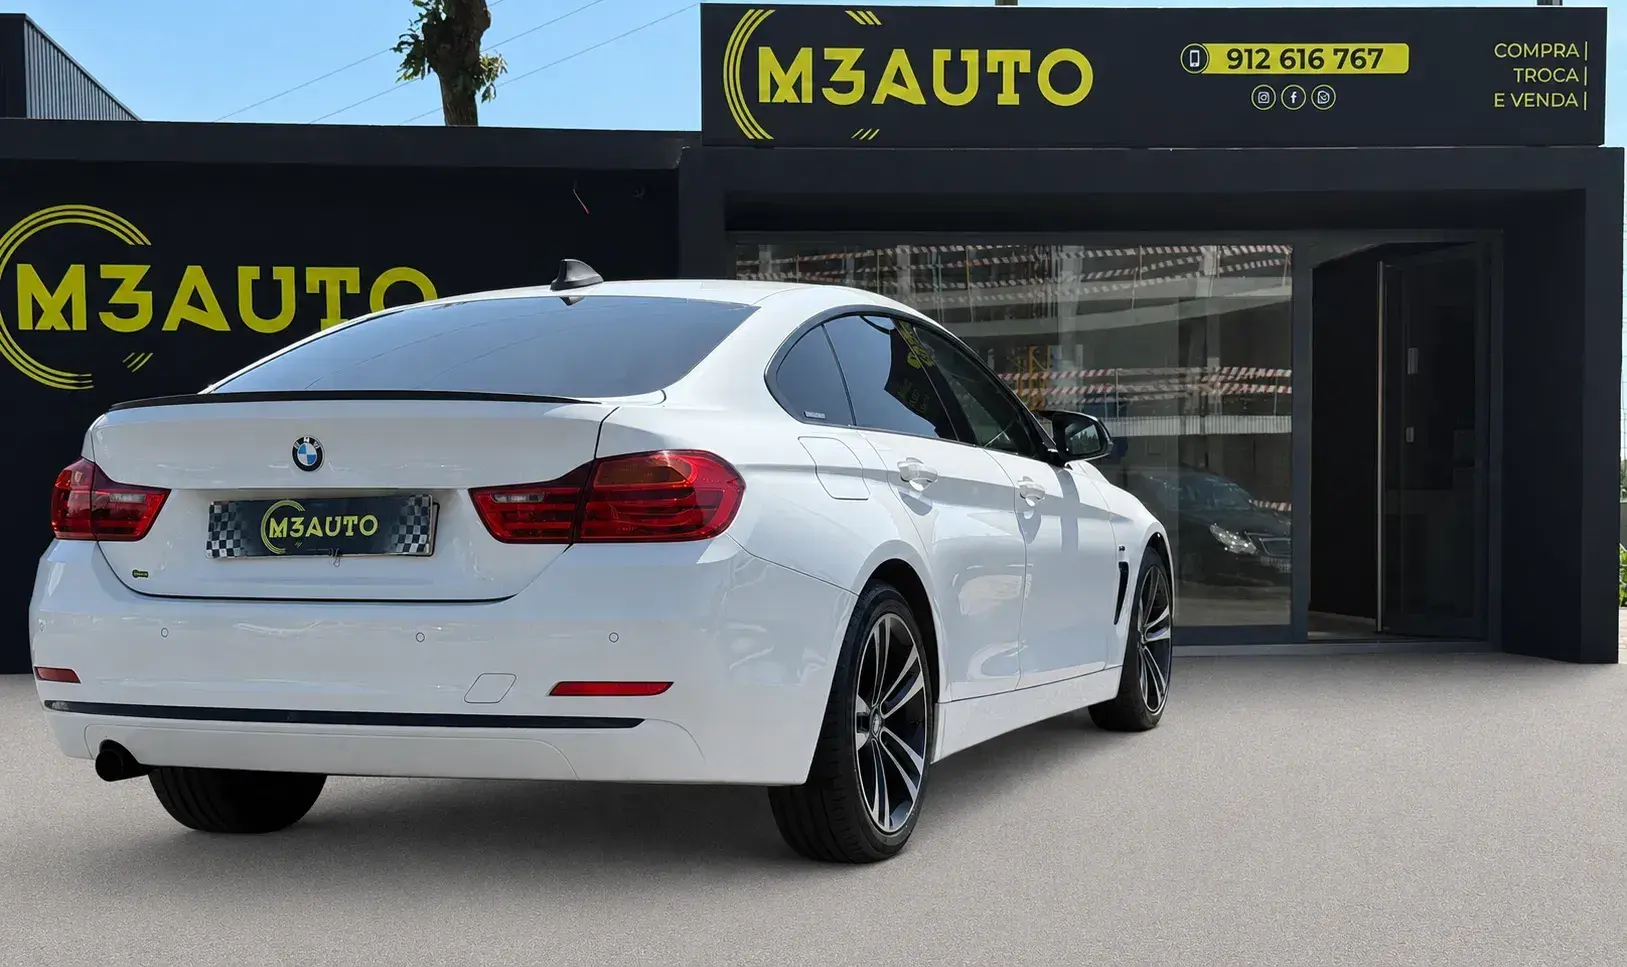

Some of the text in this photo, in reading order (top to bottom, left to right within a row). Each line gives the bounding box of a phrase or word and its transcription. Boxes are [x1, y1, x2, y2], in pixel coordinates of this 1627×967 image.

[1226, 48, 1384, 70] 912 616 767
[1494, 42, 1580, 59] COMPRA
[758, 47, 1094, 106] M3AUTO
[1513, 67, 1580, 83] TROCA
[1494, 92, 1579, 108] E VENDA
[269, 514, 379, 539] M3AUTO
